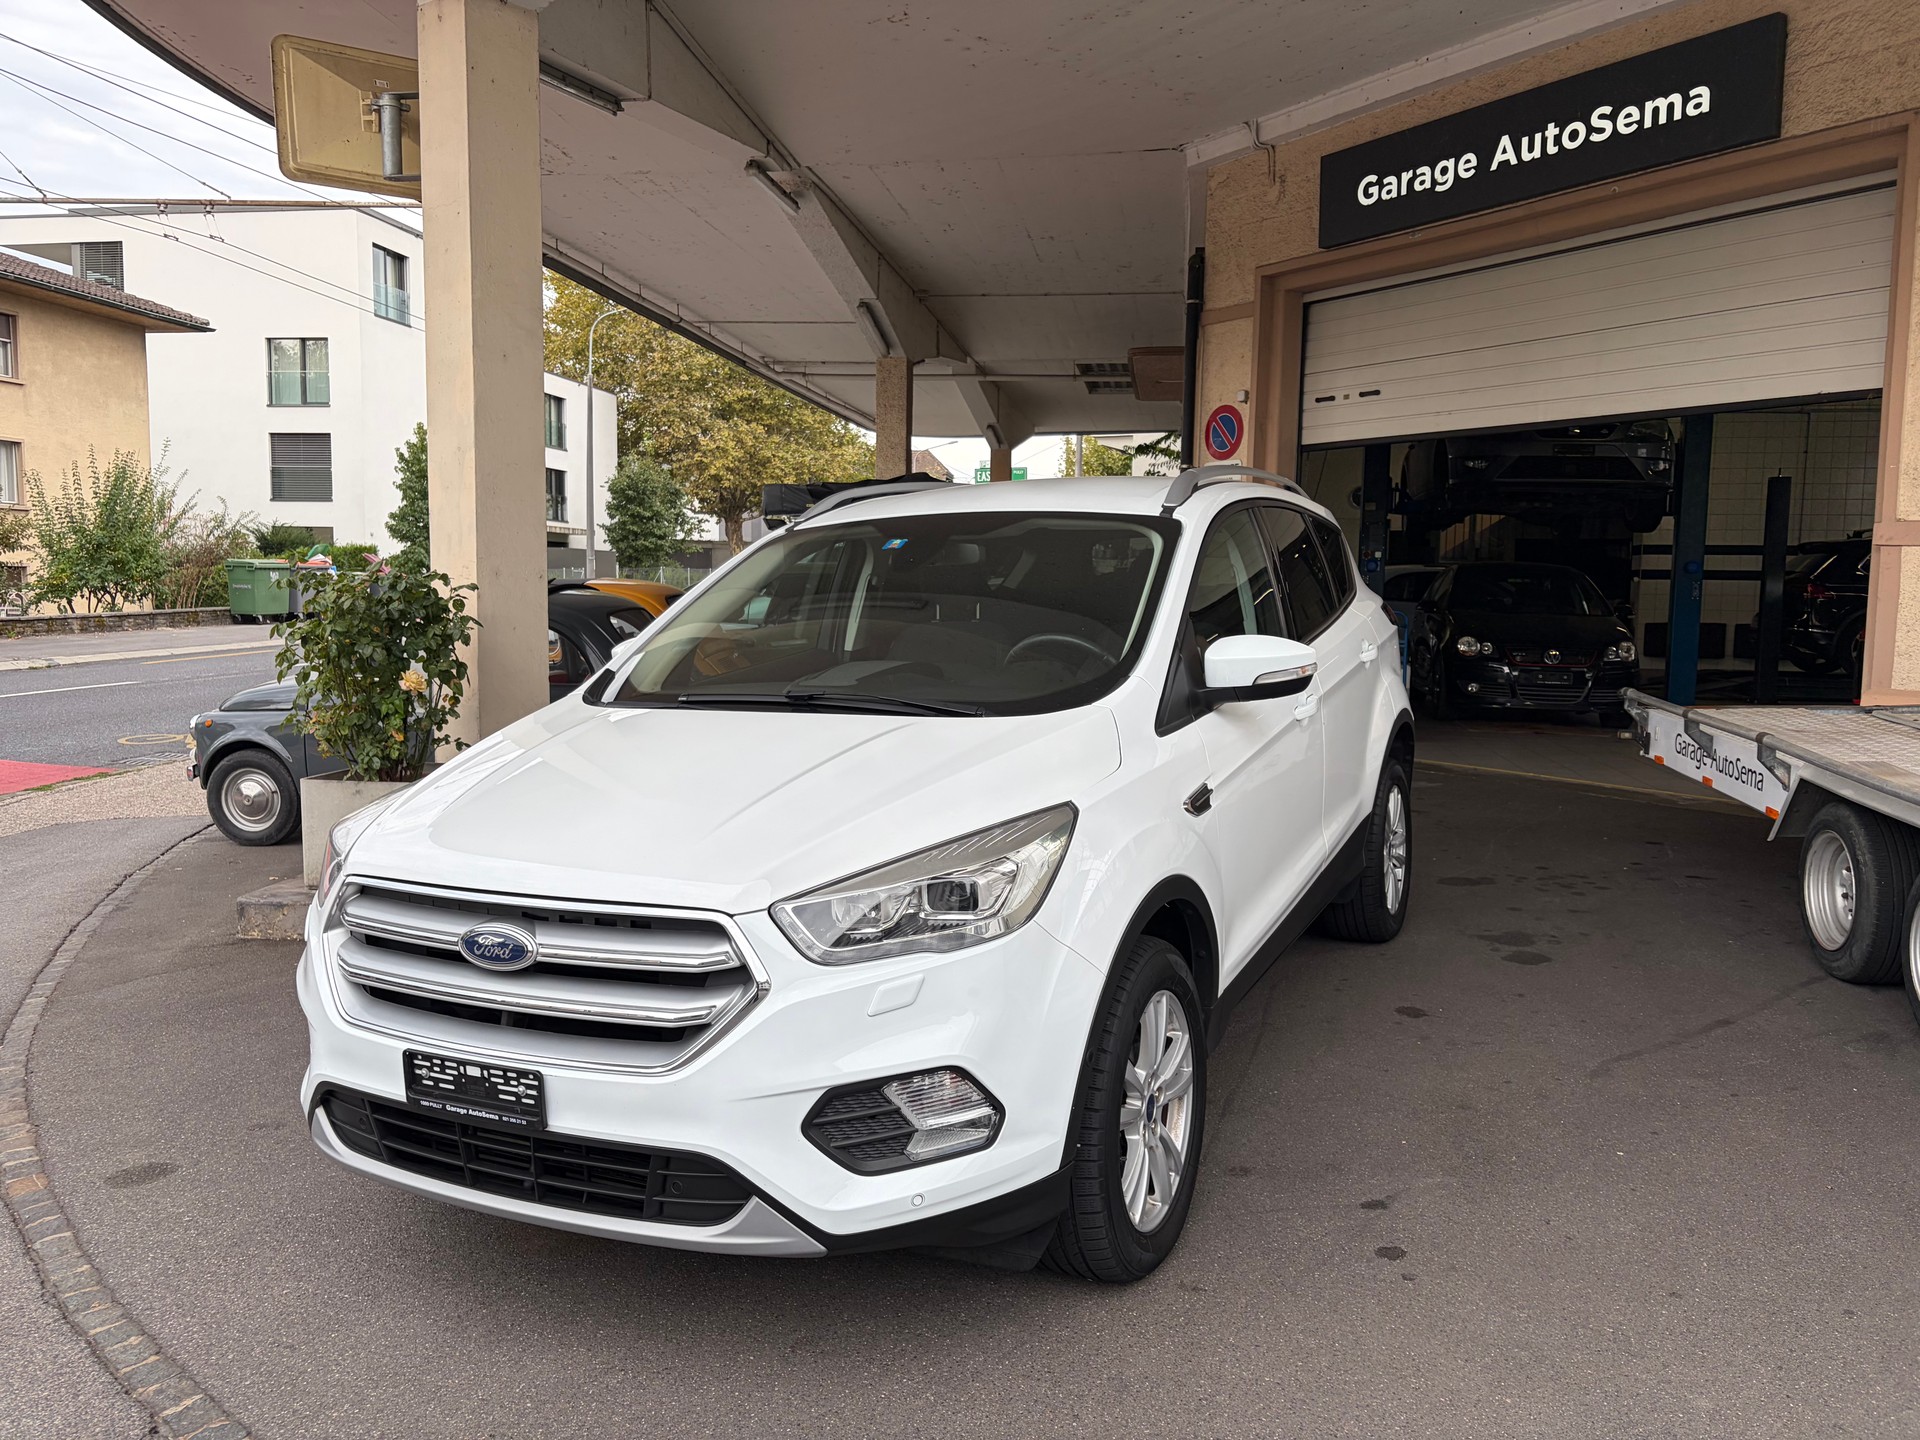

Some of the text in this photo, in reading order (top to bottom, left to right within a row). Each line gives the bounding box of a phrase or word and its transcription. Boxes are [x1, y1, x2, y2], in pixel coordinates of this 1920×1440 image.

[1357, 85, 1712, 206] Garage AutoSema
[977, 471, 991, 482] EAS
[1674, 733, 1764, 792] Garage AutoSema
[473, 934, 514, 959] Ford
[445, 1104, 468, 1115] Garage
[468, 1108, 500, 1121] AutoSema
